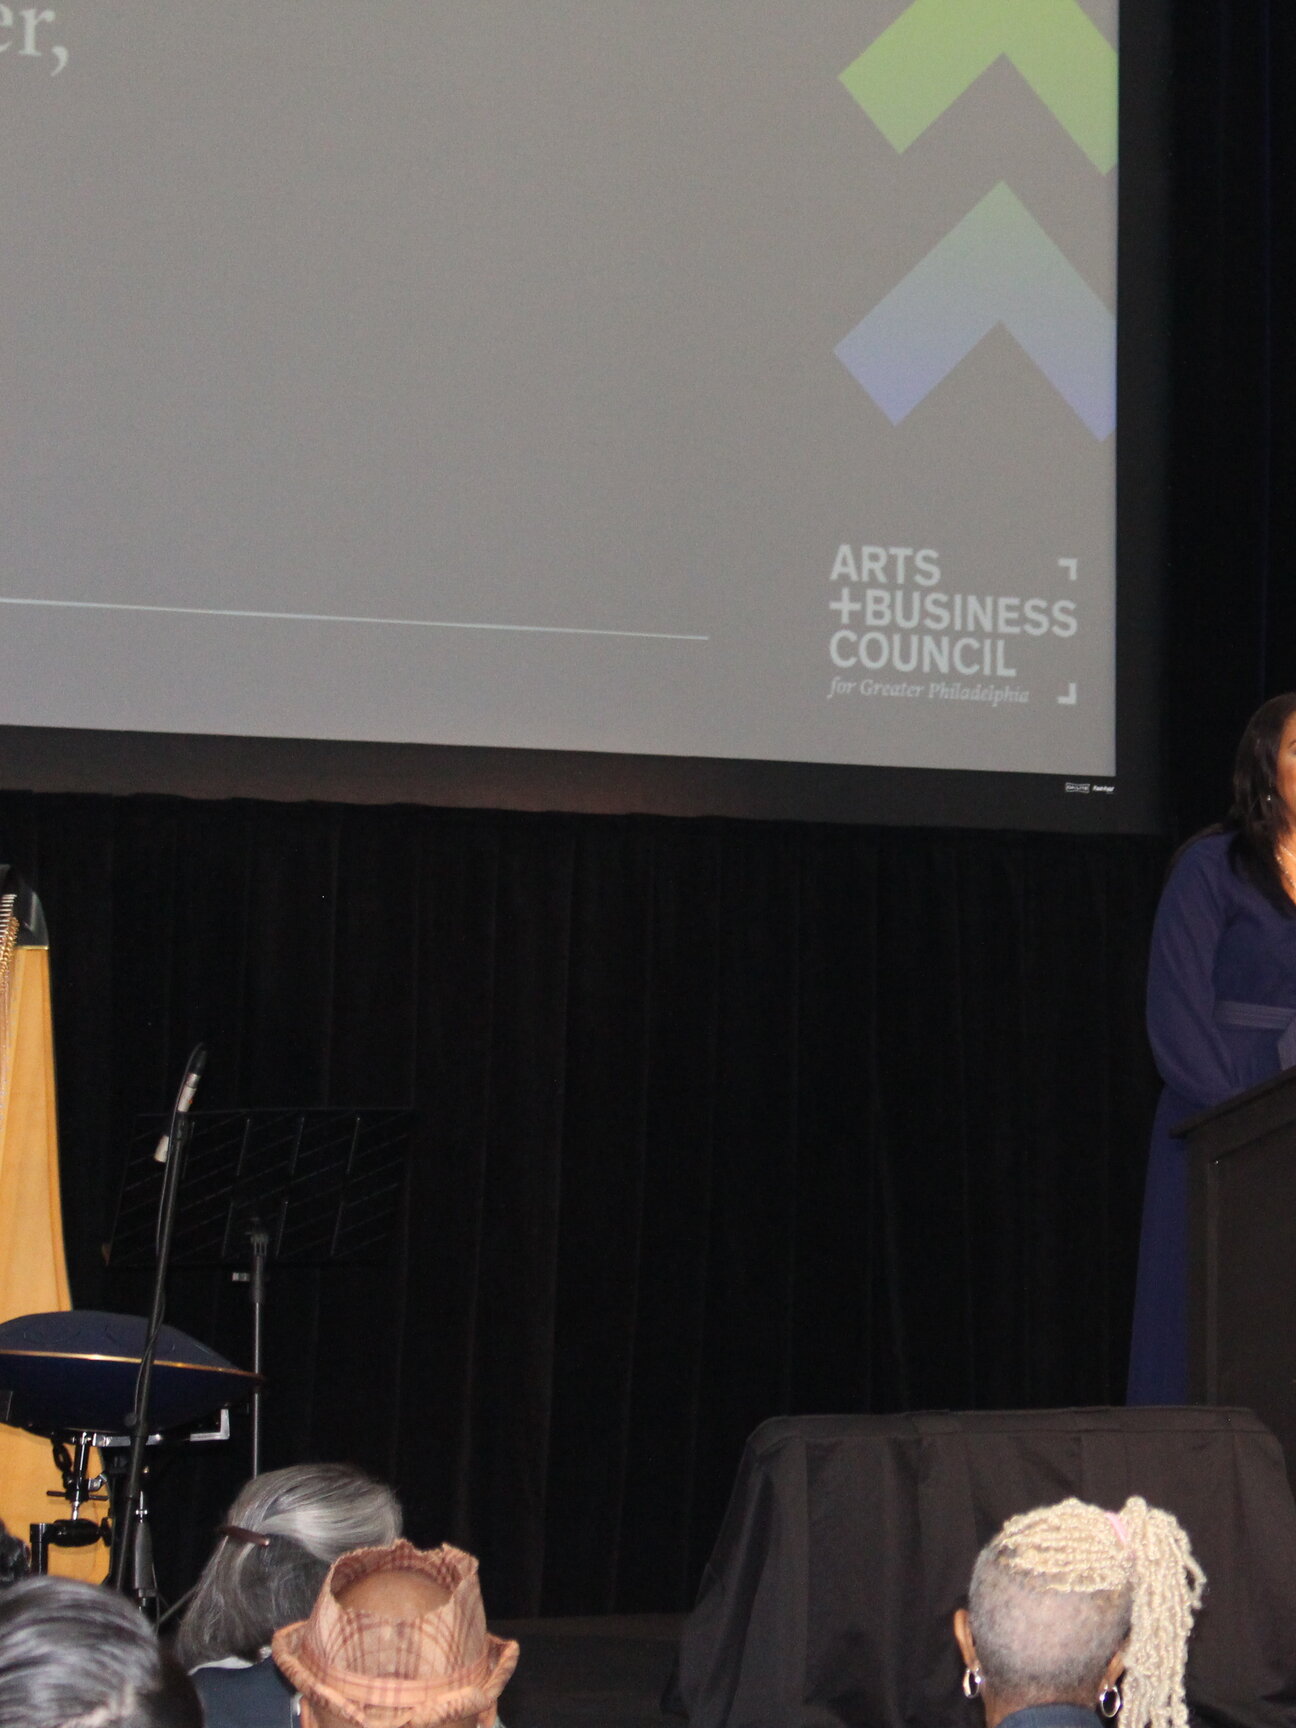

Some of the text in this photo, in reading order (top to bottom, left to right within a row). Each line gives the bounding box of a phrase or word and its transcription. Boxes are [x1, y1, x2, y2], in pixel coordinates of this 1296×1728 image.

[829, 544, 942, 586] ARTS
[829, 629, 1016, 677] COUNCIL
[827, 676, 1030, 707] for Greater Philadelphia
